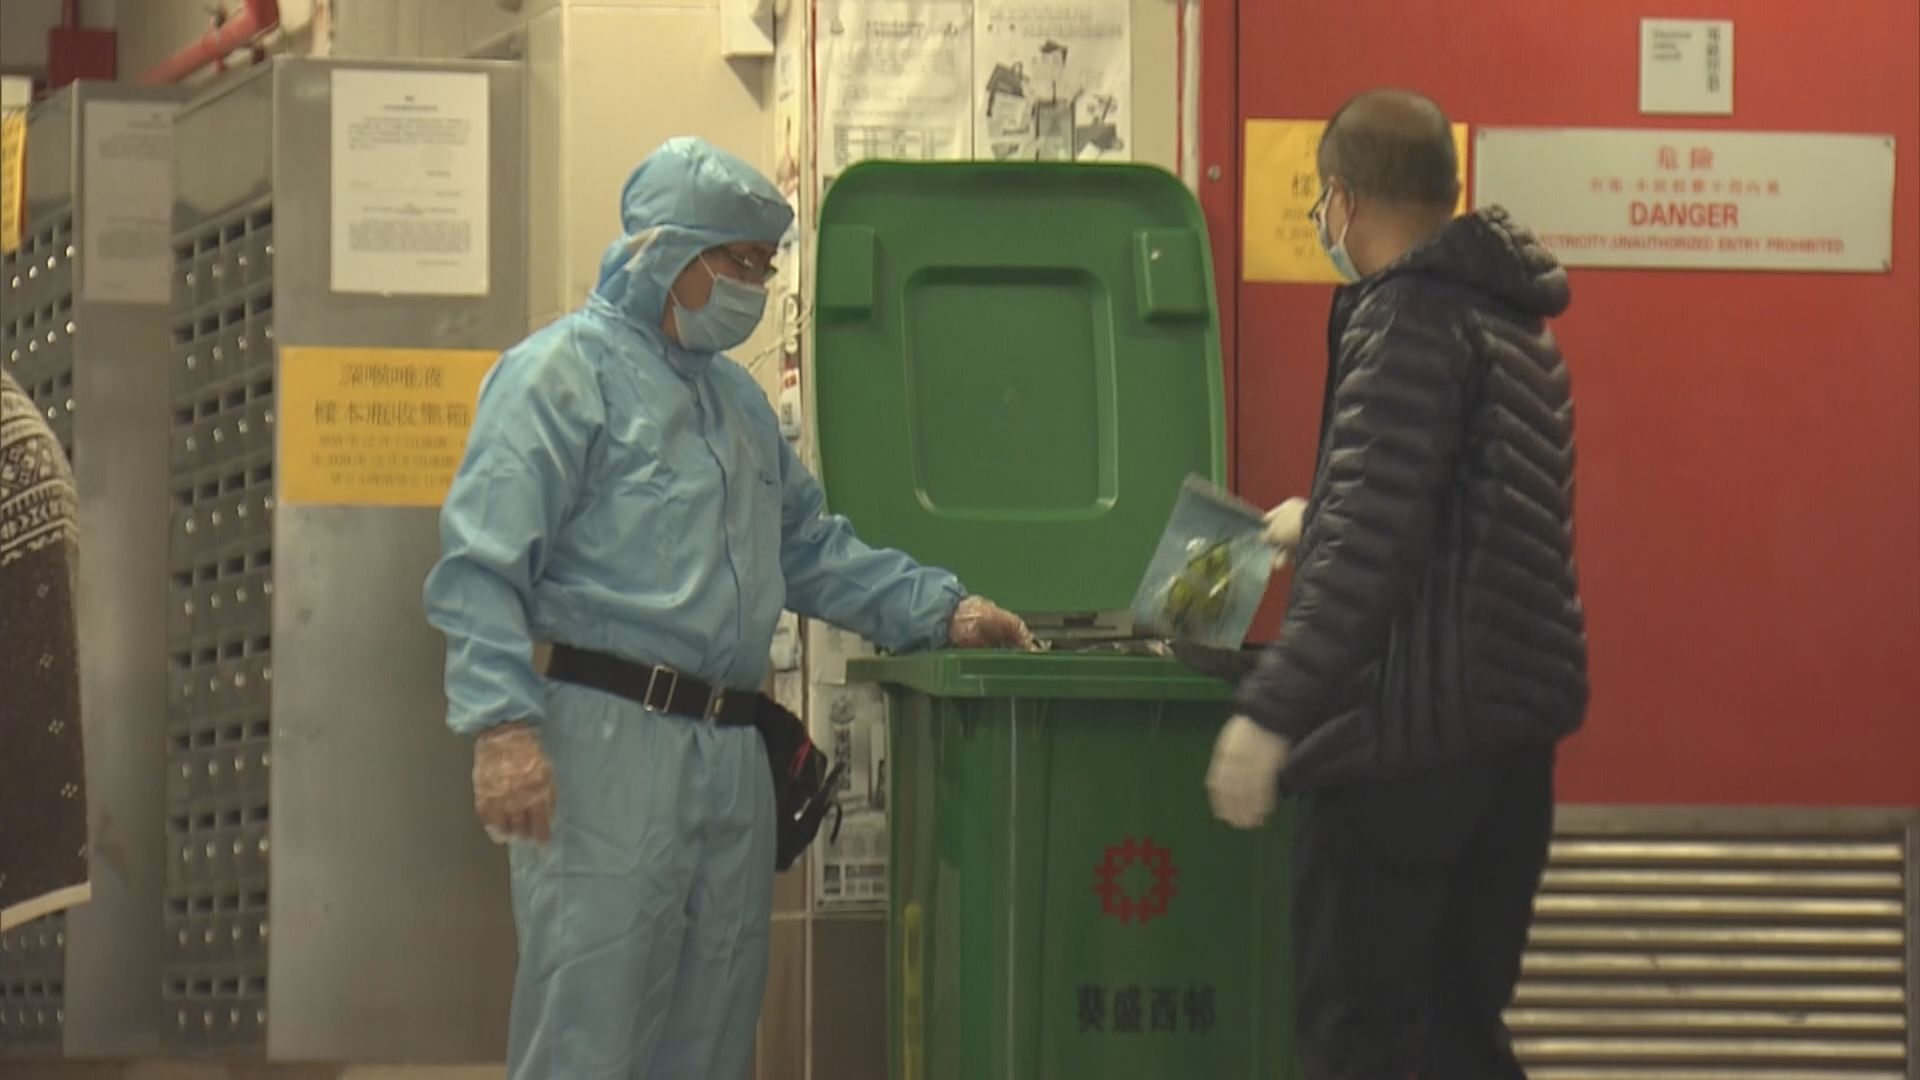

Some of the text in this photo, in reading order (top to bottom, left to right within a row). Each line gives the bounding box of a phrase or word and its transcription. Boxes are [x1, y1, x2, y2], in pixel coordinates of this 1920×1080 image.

[1629, 201, 1739, 228] DANGER
[1718, 236, 1760, 252] ENTRY
[1765, 237, 1845, 254] PROHIBITED
